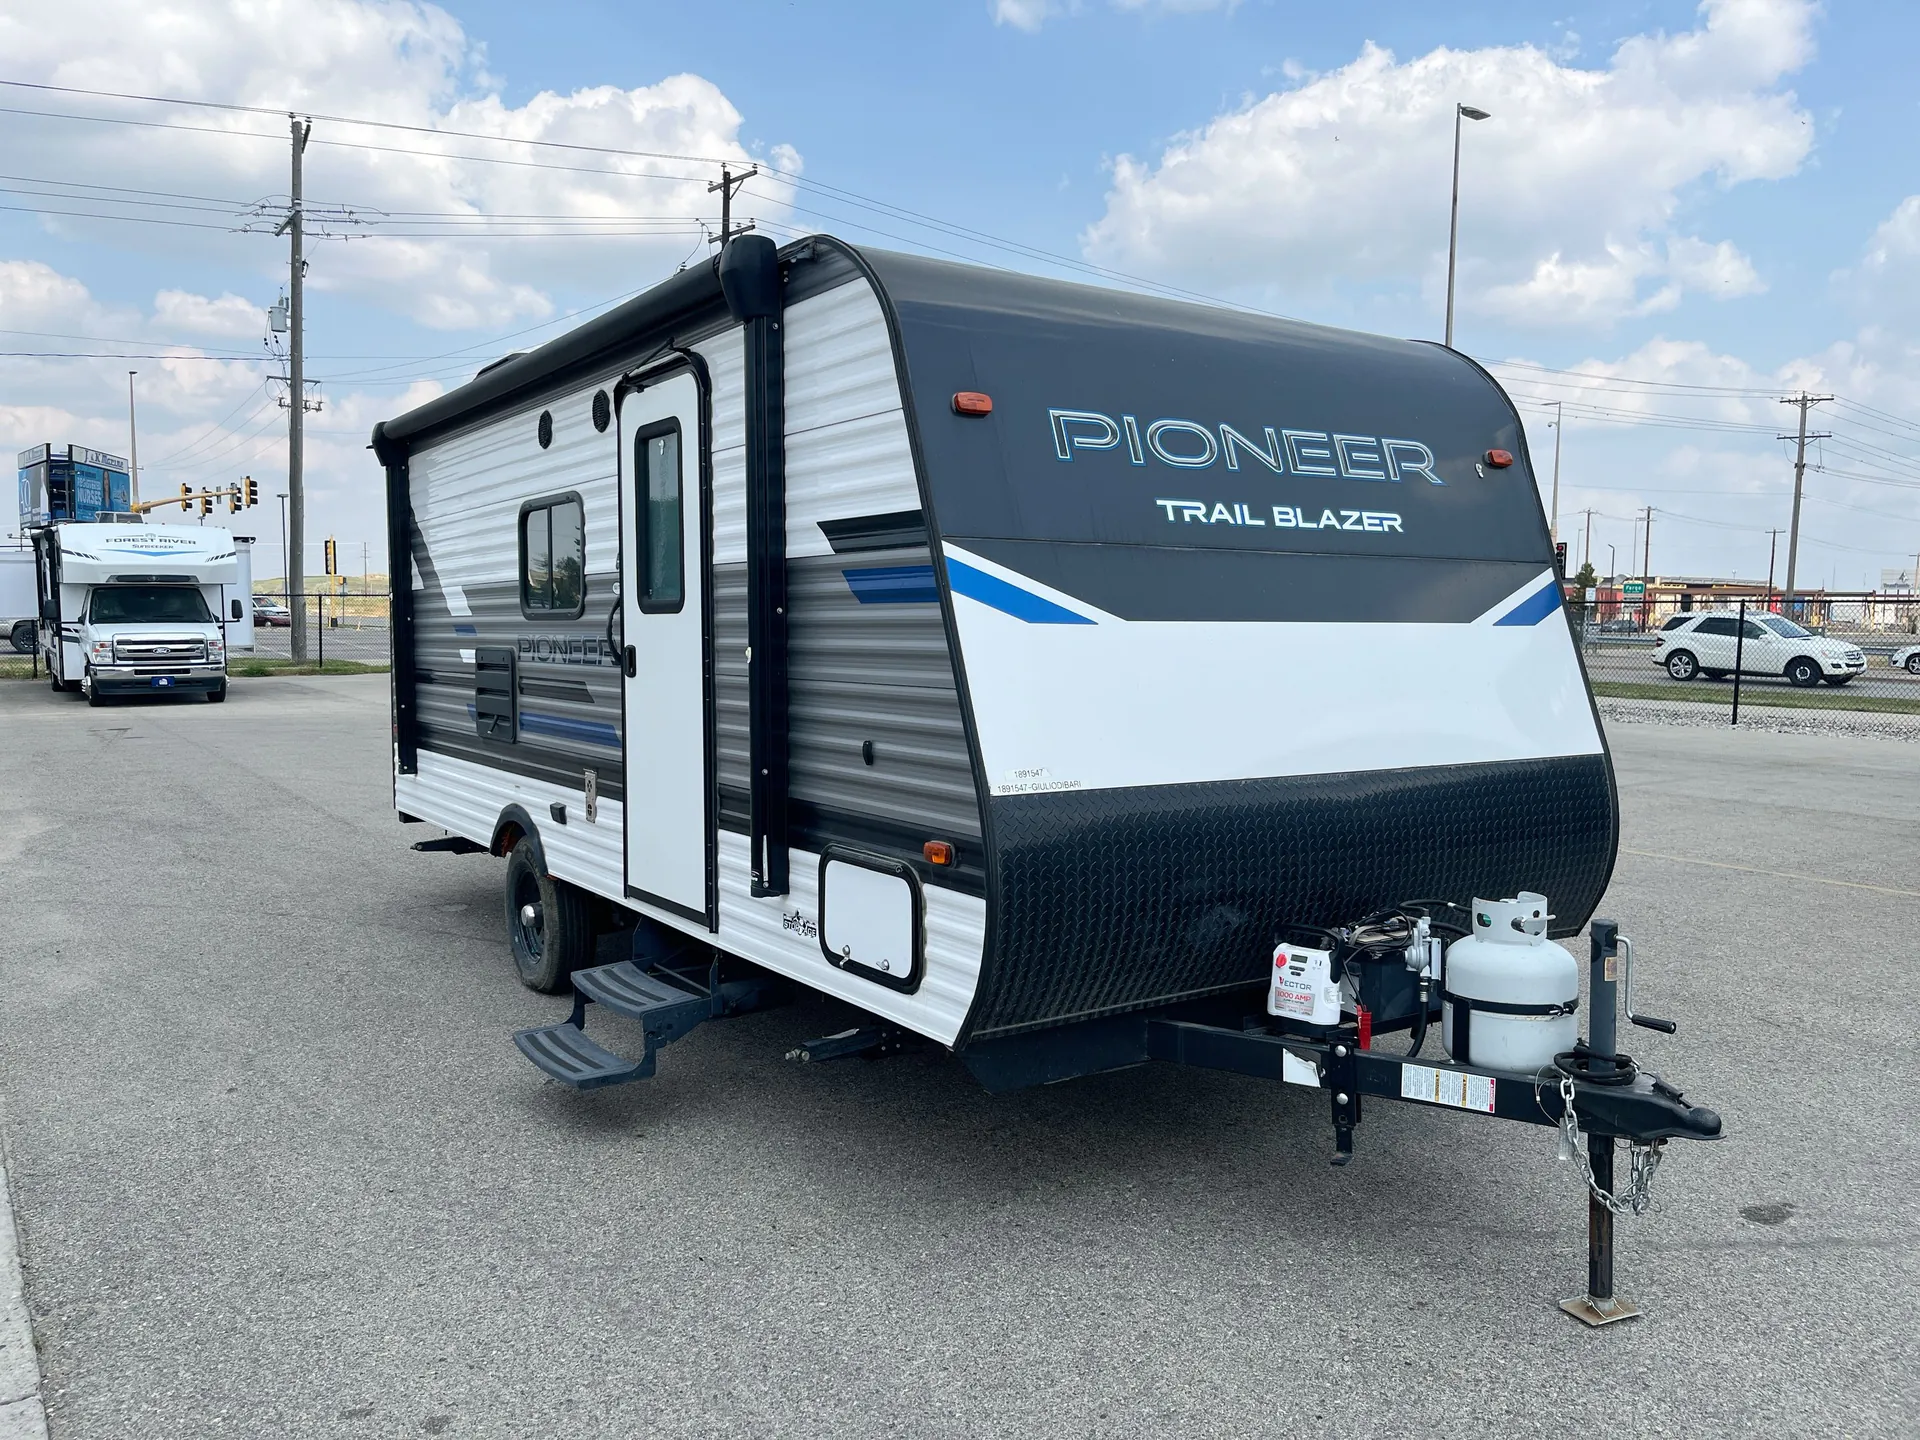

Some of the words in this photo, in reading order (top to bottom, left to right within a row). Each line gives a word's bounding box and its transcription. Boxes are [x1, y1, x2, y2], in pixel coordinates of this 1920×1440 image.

[1047, 407, 1448, 486] PIONEER
[77, 488, 102, 506] NURSES
[1155, 498, 1265, 526] TRAIL
[1272, 506, 1404, 532] BLAZER
[1014, 768, 1044, 779] 1891547
[1279, 976, 1312, 991] VECTOR
[1277, 990, 1294, 999] 1000
[1294, 994, 1312, 1002] AMP
